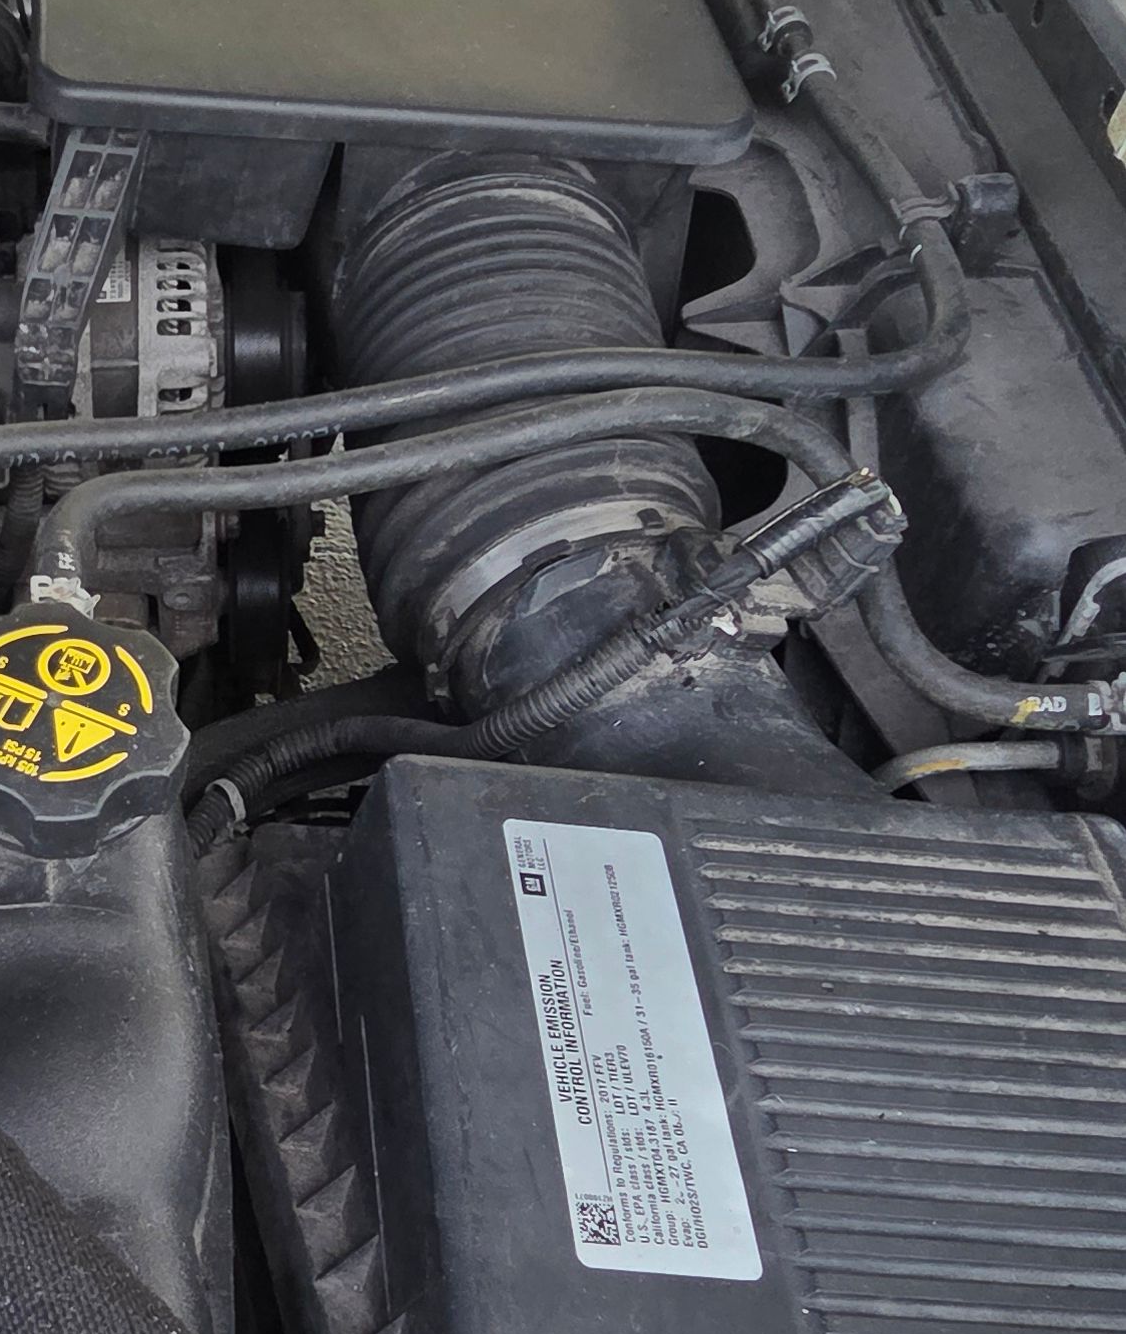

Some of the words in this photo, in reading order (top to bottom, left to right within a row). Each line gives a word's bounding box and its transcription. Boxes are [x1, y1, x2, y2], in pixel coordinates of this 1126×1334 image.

[3, 739, 26, 756] PSI
[563, 909, 587, 987] Gasoline/Ethanol
[620, 938, 634, 962] tank:
[626, 965, 639, 980] gal
[537, 973, 561, 1039] EMISSION
[549, 959, 578, 1052] INFORMATION
[578, 990, 593, 1015] Fuel:
[550, 1044, 572, 1102] VEHICLE
[591, 1054, 604, 1074] FFV
[604, 1051, 619, 1082] TIER3
[615, 1044, 632, 1084] ULEV70
[567, 1056, 592, 1125] CONTROL
[595, 1078, 610, 1103] 2017
[612, 1092, 625, 1114] LDT
[638, 1088, 652, 1111] 4.3L
[625, 1094, 639, 1115] LDT
[618, 1127, 632, 1151] stds:
[631, 1126, 646, 1151] stds:
[657, 1114, 672, 1140] tank:
[601, 1109, 625, 1173] Regulations:
[663, 1144, 678, 1161] gal
[675, 1139, 688, 1154] CA
[613, 1176, 626, 1187] to
[625, 1163, 640, 1190] class
[639, 1163, 653, 1189] class
[616, 1191, 636, 1242] Conforms
[631, 1194, 645, 1215] EPA
[645, 1193, 665, 1244] California
[662, 1210, 682, 1246] Group:
[678, 1217, 695, 1247] Evap:
